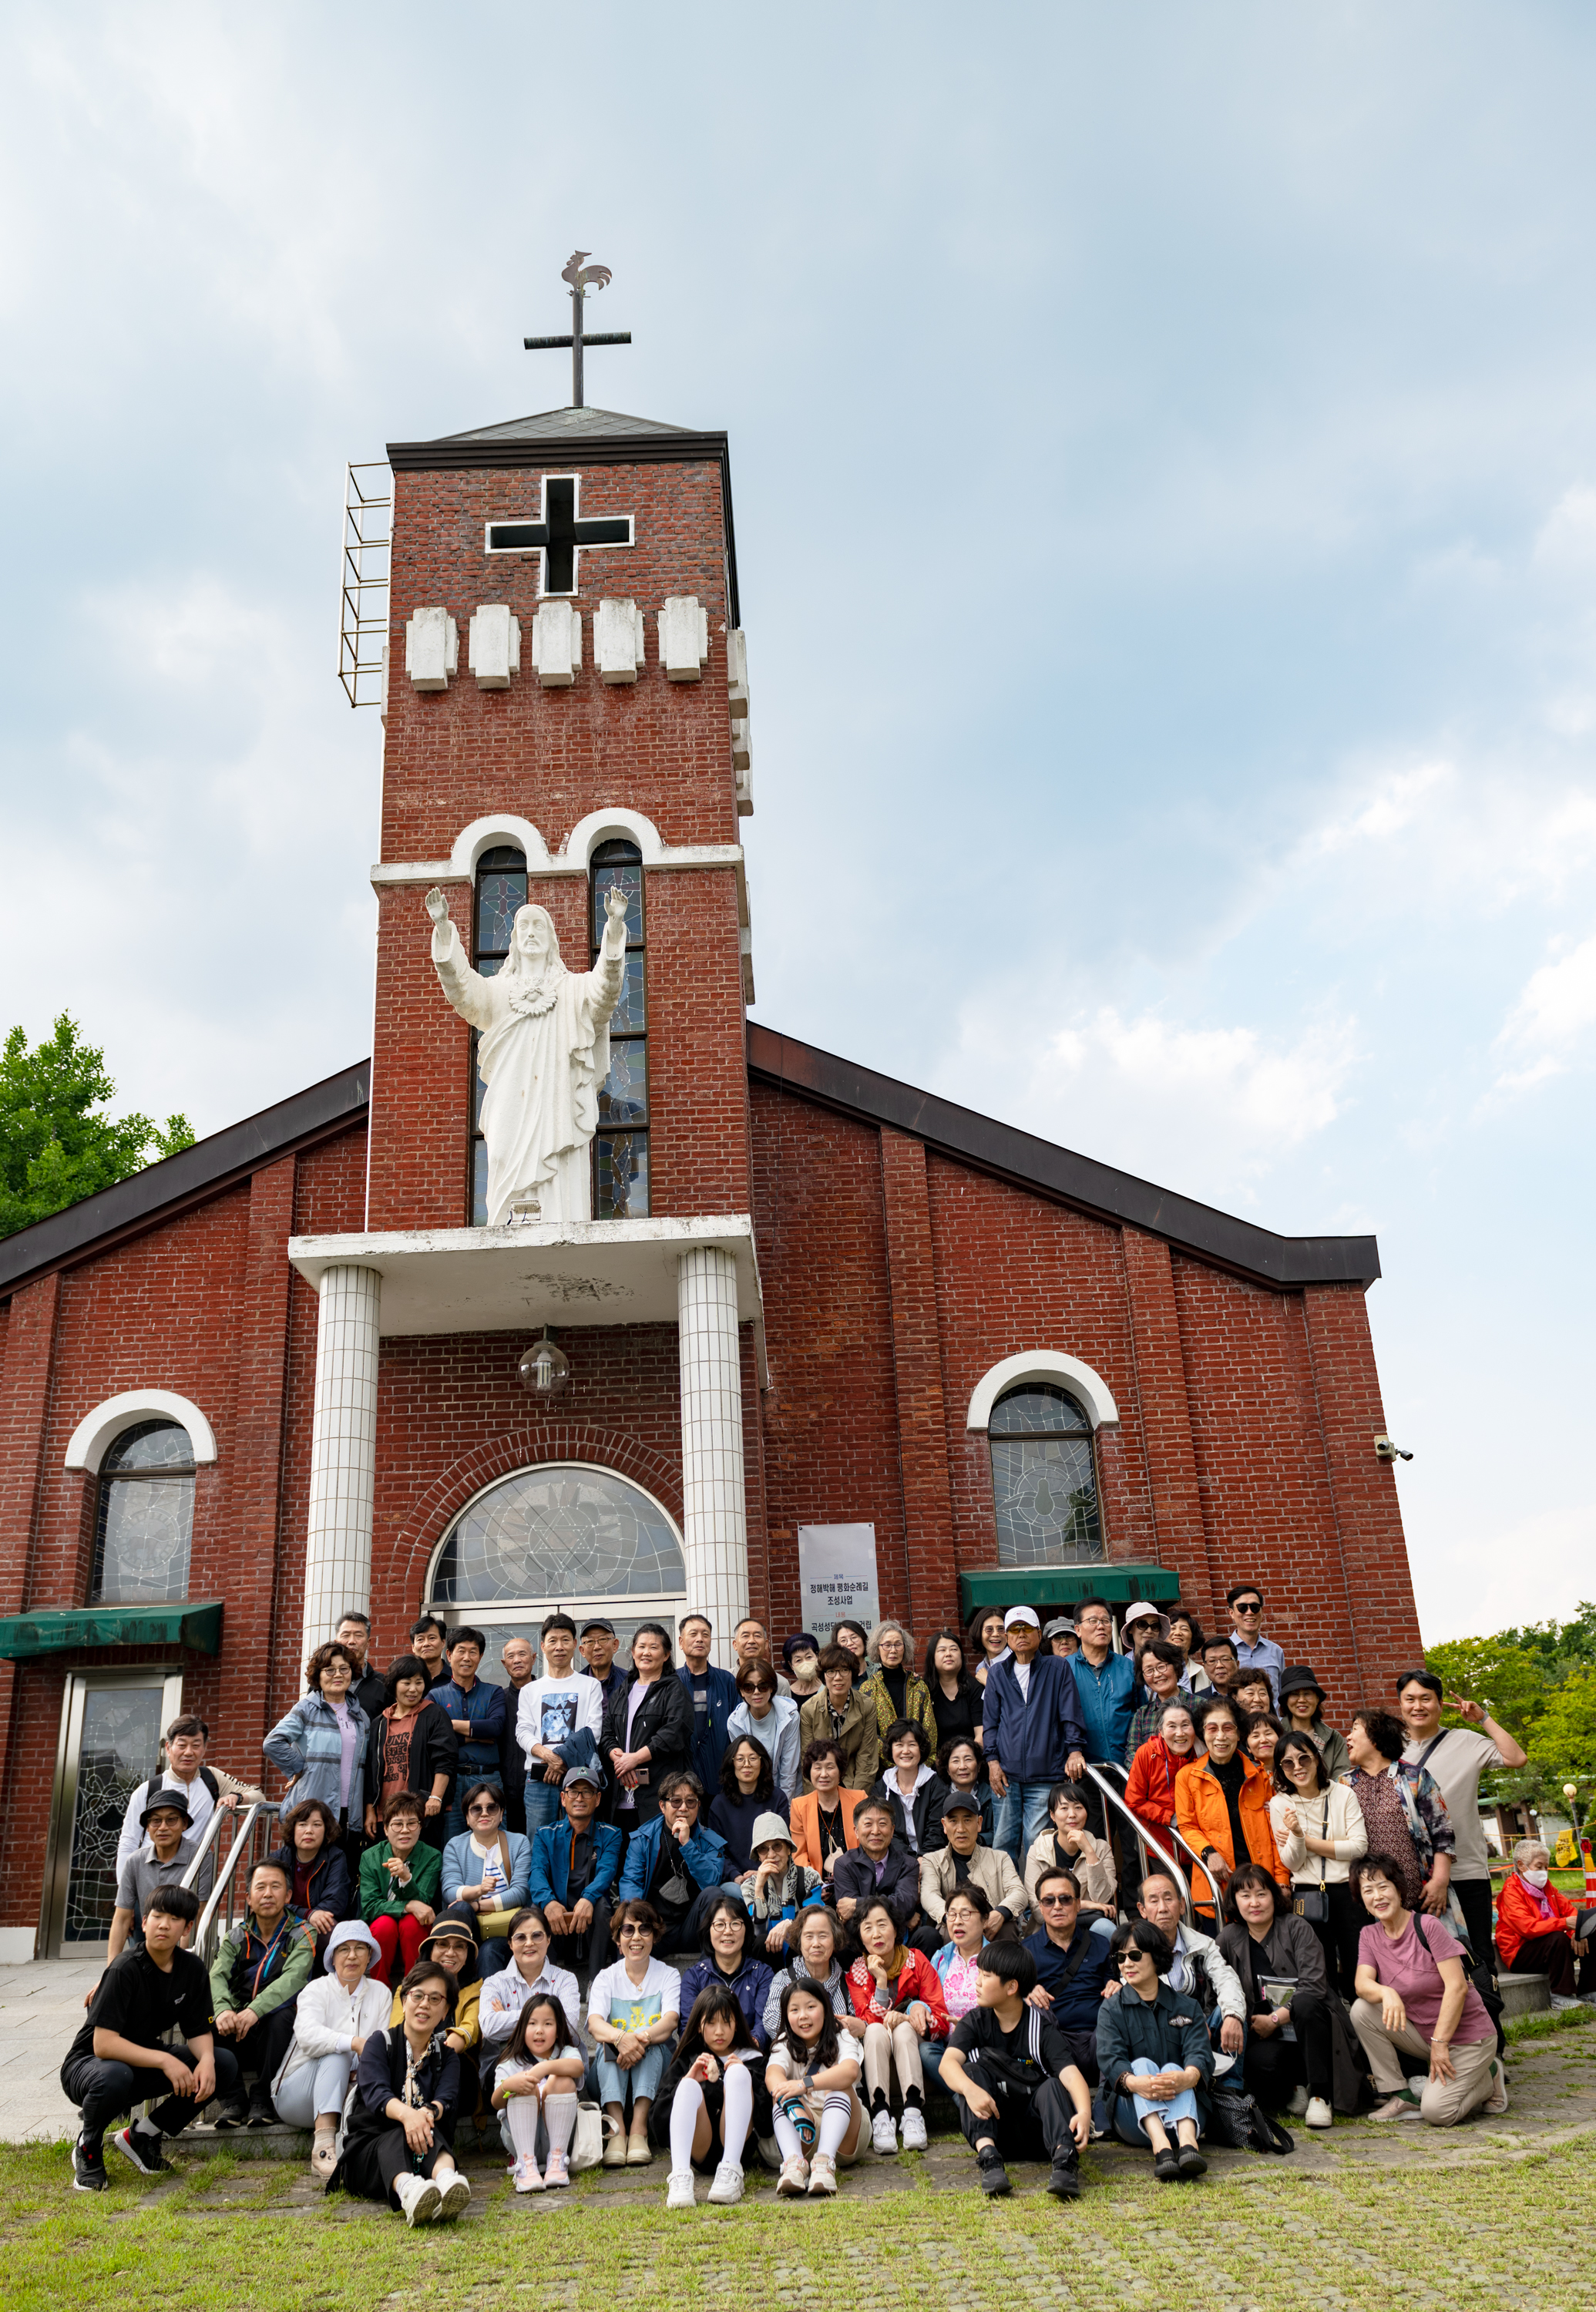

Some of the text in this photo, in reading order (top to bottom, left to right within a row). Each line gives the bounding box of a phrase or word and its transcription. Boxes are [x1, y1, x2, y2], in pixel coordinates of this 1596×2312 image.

[810, 1581, 869, 1594] 정해박해 평화순례길
[828, 1595, 852, 1605] 조성사업
